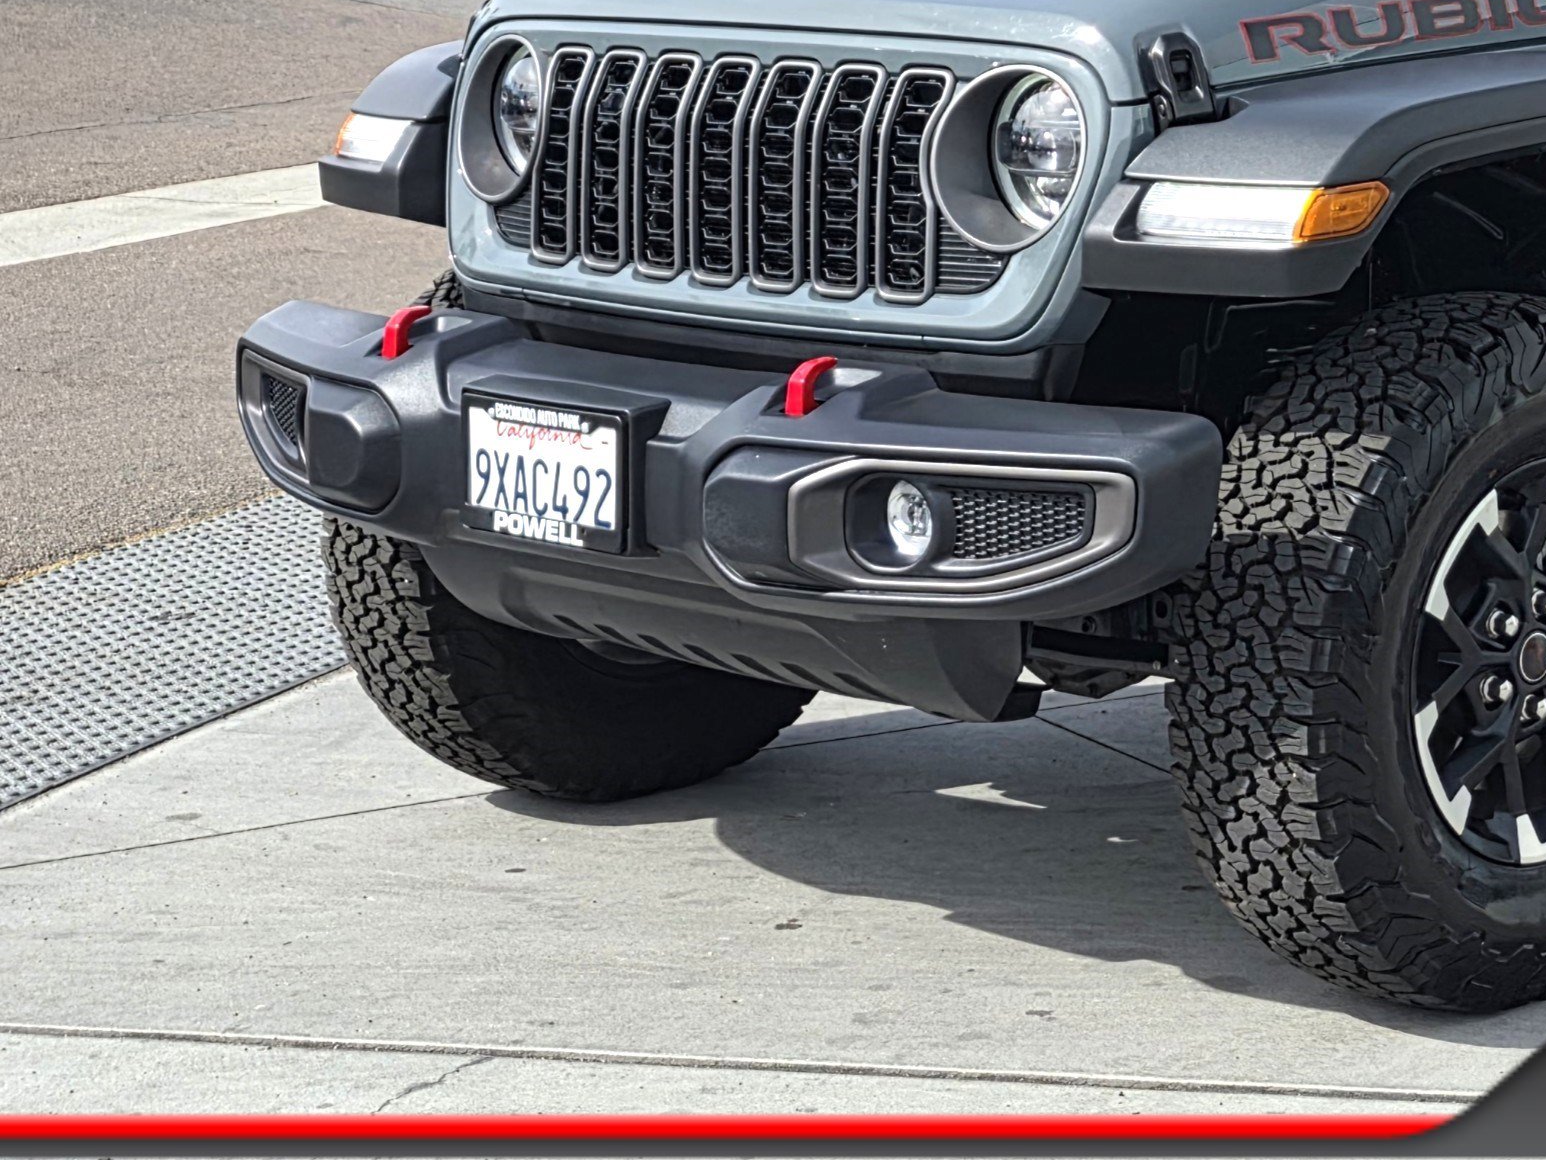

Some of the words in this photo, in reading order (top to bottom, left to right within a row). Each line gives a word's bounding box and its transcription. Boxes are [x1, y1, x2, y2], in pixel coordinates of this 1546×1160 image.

[558, 412, 581, 431] PARK
[476, 447, 612, 529] 9XAC492
[494, 510, 584, 547] POWELL
